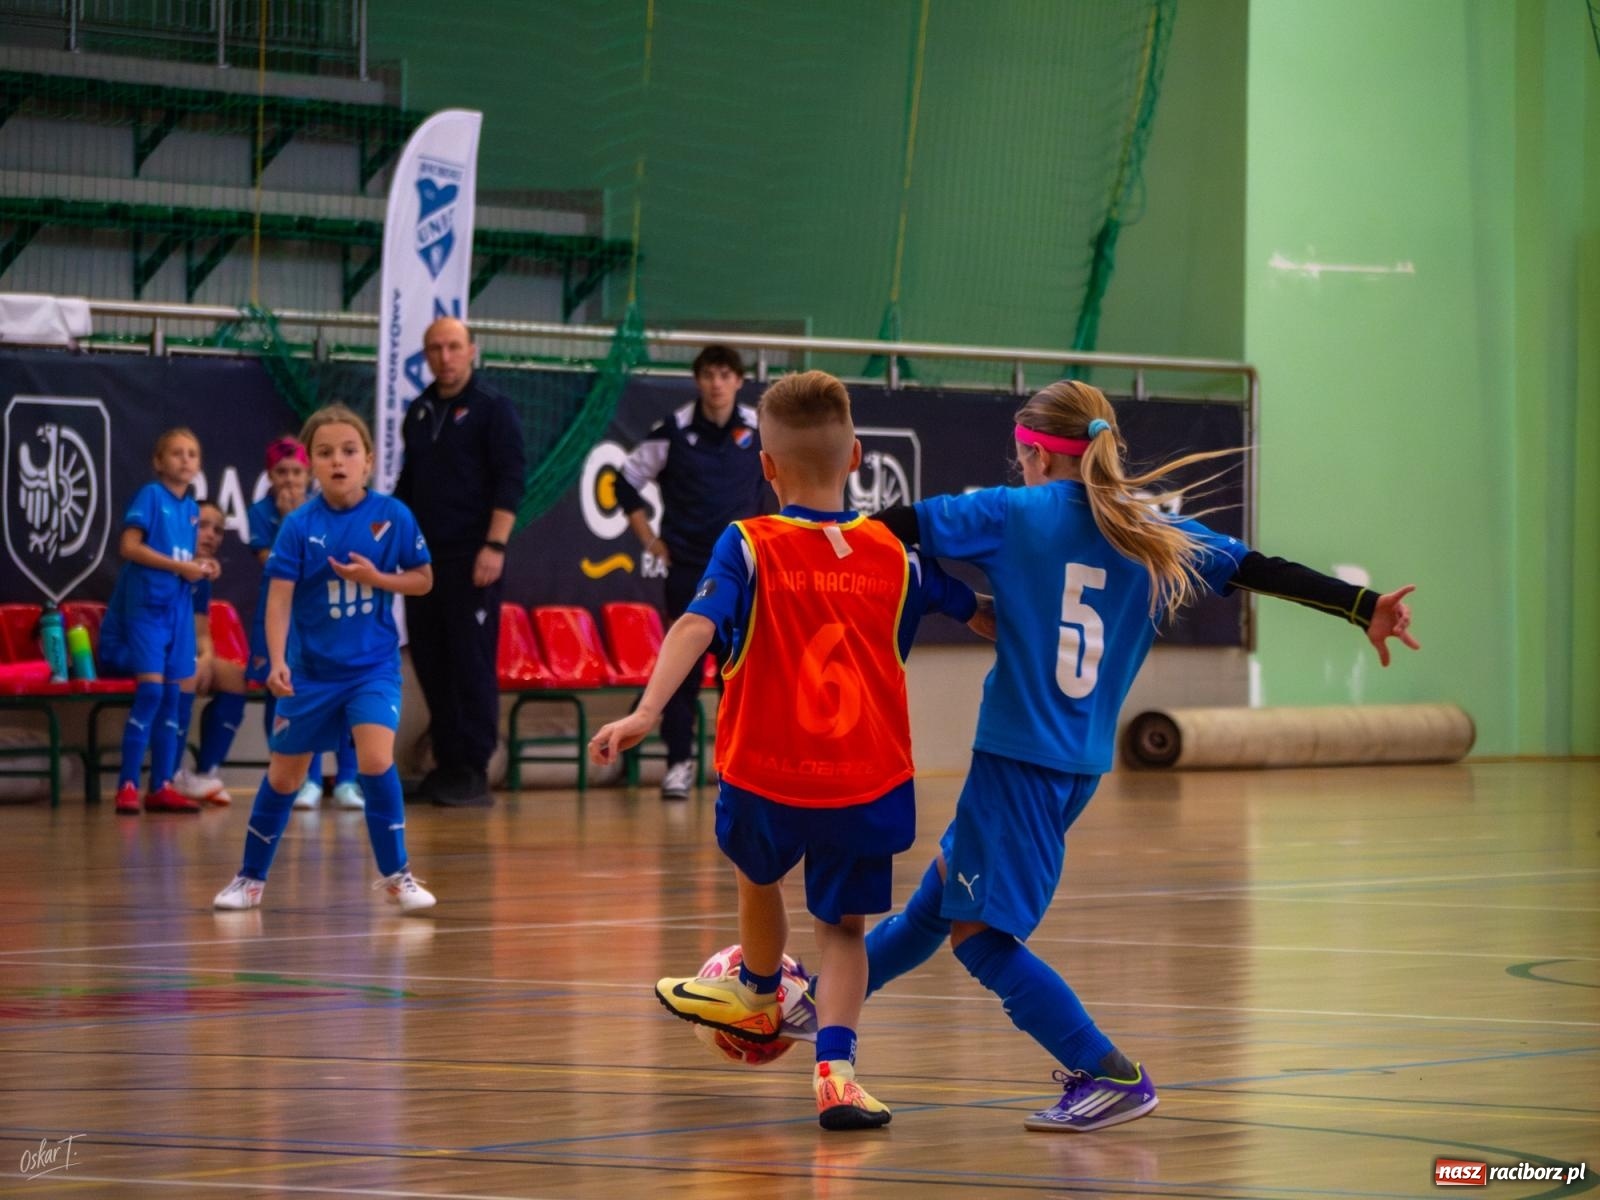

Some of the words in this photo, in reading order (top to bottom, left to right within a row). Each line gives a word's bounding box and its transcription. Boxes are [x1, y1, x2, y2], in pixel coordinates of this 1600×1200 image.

[387, 288, 402, 410] SPORTOWY
[796, 623, 861, 738] 6
[1055, 562, 1106, 699] 5
